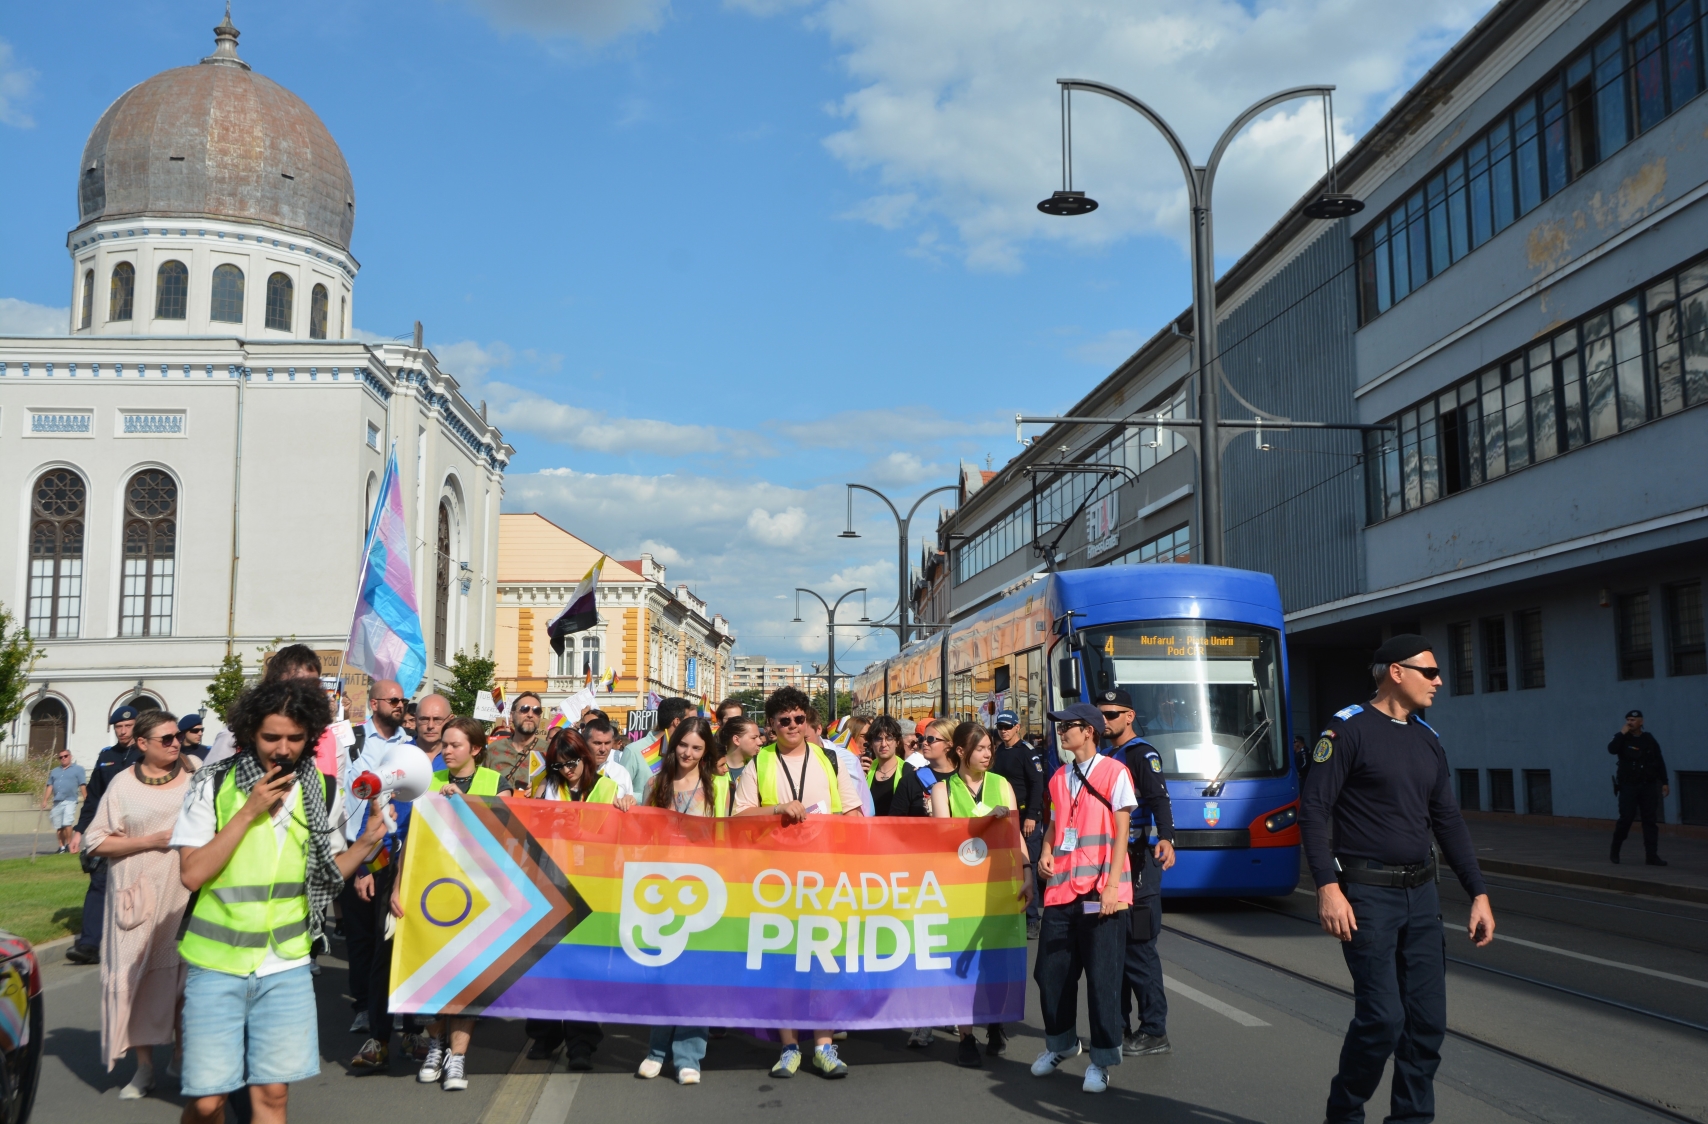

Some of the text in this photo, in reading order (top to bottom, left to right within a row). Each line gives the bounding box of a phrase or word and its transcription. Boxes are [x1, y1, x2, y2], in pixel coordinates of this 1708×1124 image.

[1104, 635, 1115, 657] 4
[1140, 635, 1175, 646] Nufarul
[1210, 636, 1234, 646] Unirii
[1167, 646, 1185, 656] Pod
[323, 656, 339, 667] YOU
[345, 673, 367, 686] HATE
[752, 868, 948, 911] ORADEA
[746, 912, 952, 973] PRIDE
